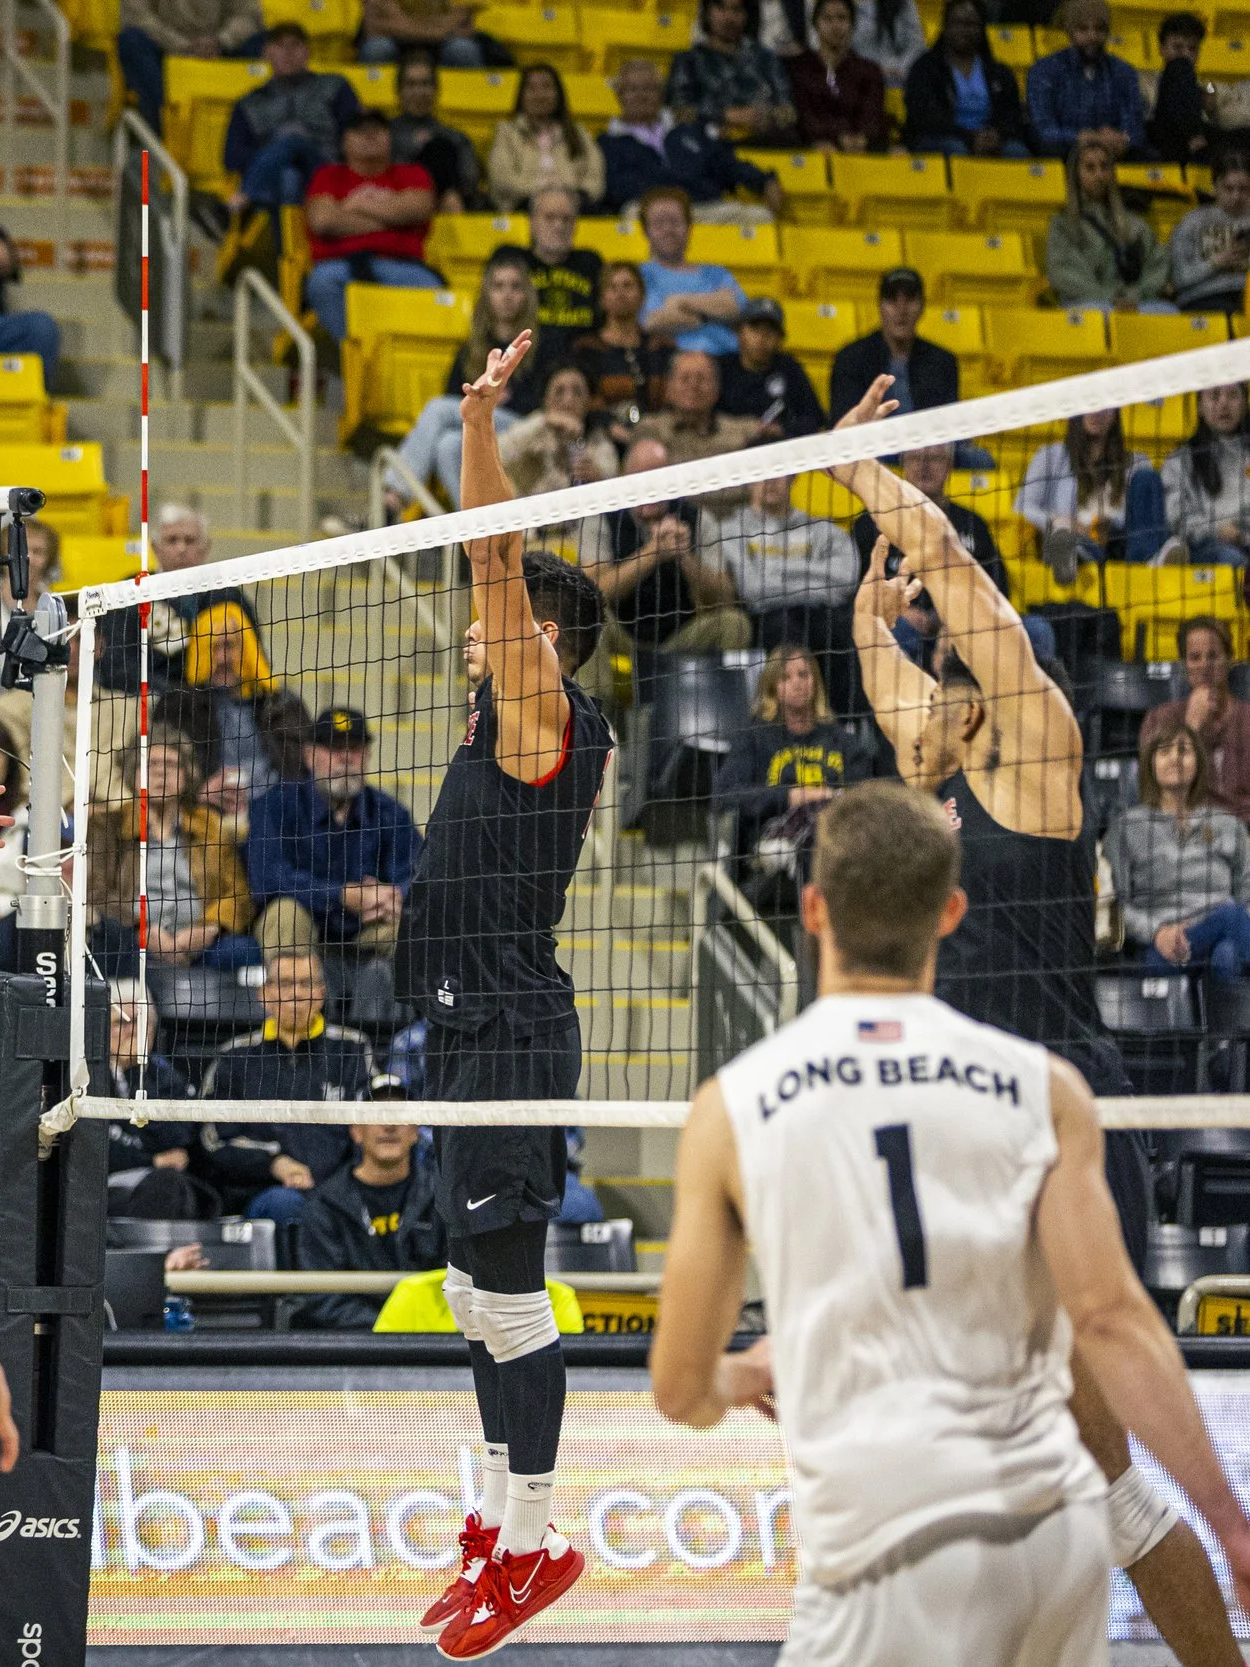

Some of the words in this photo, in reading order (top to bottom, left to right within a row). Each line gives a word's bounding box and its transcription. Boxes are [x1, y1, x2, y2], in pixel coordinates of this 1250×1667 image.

[759, 1056, 863, 1122] LONG
[877, 1056, 1021, 1107] BEACH
[874, 1123, 928, 1290] 1
[19, 1517, 82, 1538] asics
